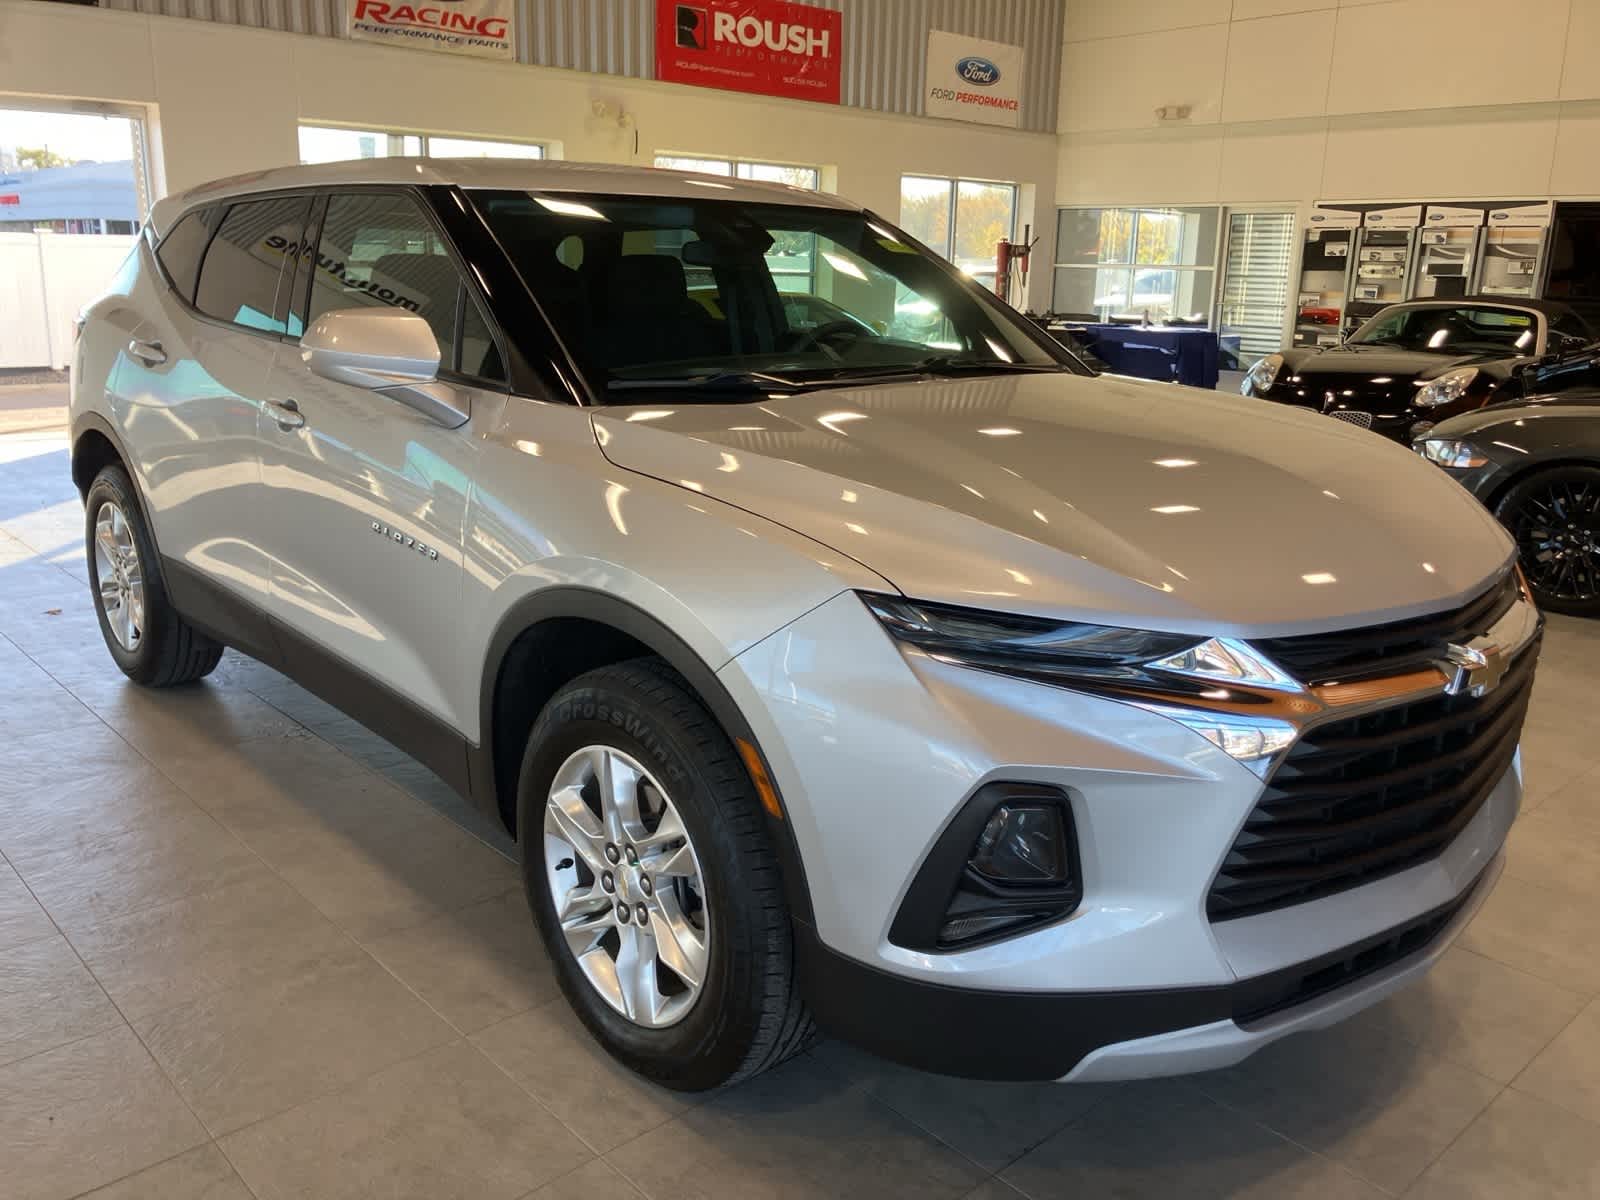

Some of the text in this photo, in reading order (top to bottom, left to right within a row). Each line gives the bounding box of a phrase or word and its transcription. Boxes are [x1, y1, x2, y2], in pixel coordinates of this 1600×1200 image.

[354, 0, 509, 39] RACING
[354, 22, 509, 49] PERFORMANCE PARTS
[714, 11, 829, 58] ROUSH
[964, 61, 993, 82] Ford
[930, 87, 1019, 111] FORD PERFORMANCE
[371, 520, 439, 561] BLAZER
